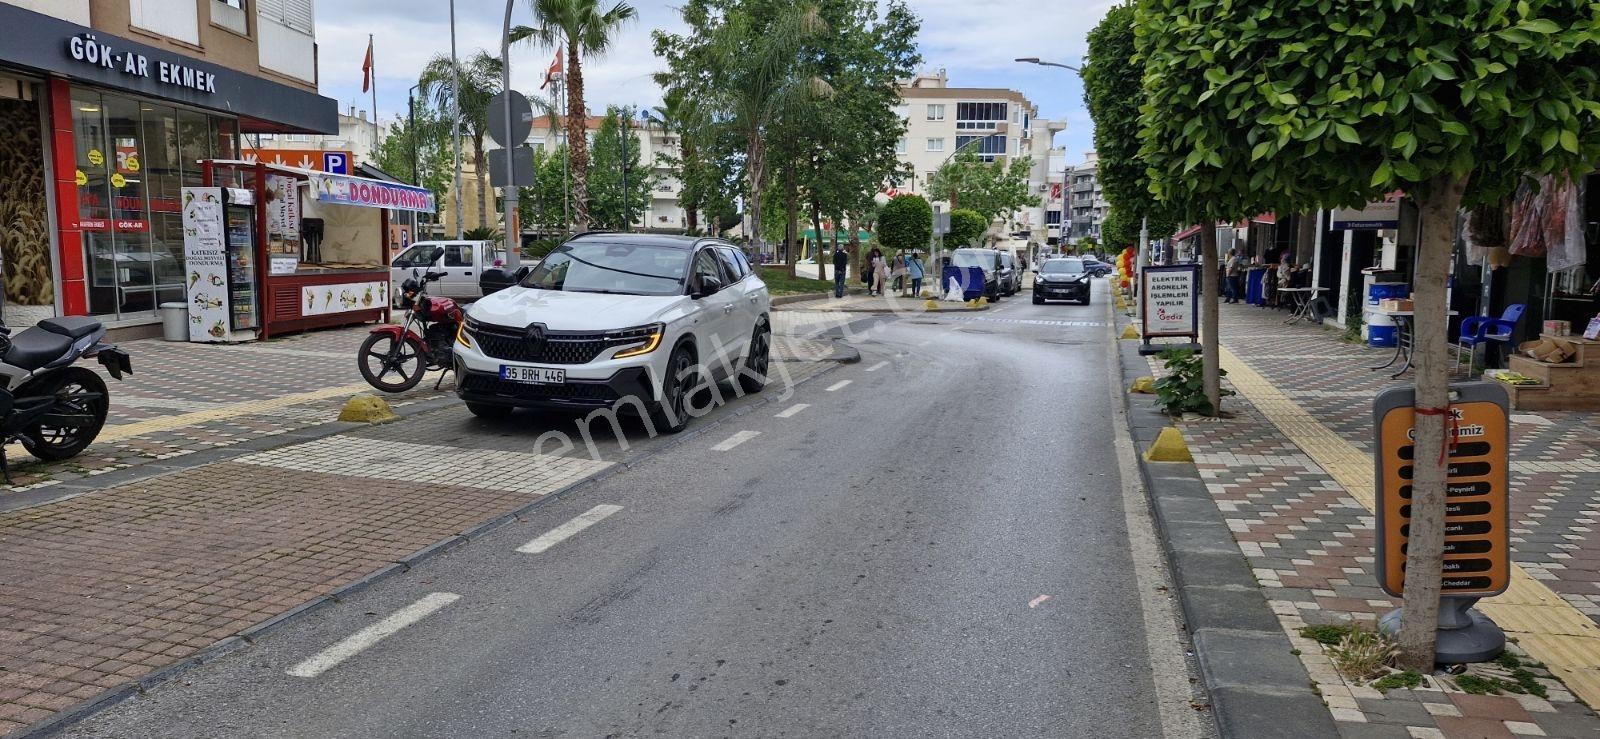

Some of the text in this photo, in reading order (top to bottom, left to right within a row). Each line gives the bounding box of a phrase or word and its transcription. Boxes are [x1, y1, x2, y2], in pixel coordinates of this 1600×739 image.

[70, 33, 216, 94] GÖK-AR EKMEK
[328, 155, 342, 173] P
[349, 182, 428, 209] DONDURMA
[1159, 313, 1183, 321] Gediz
[506, 367, 563, 382] 35 BRH 446
